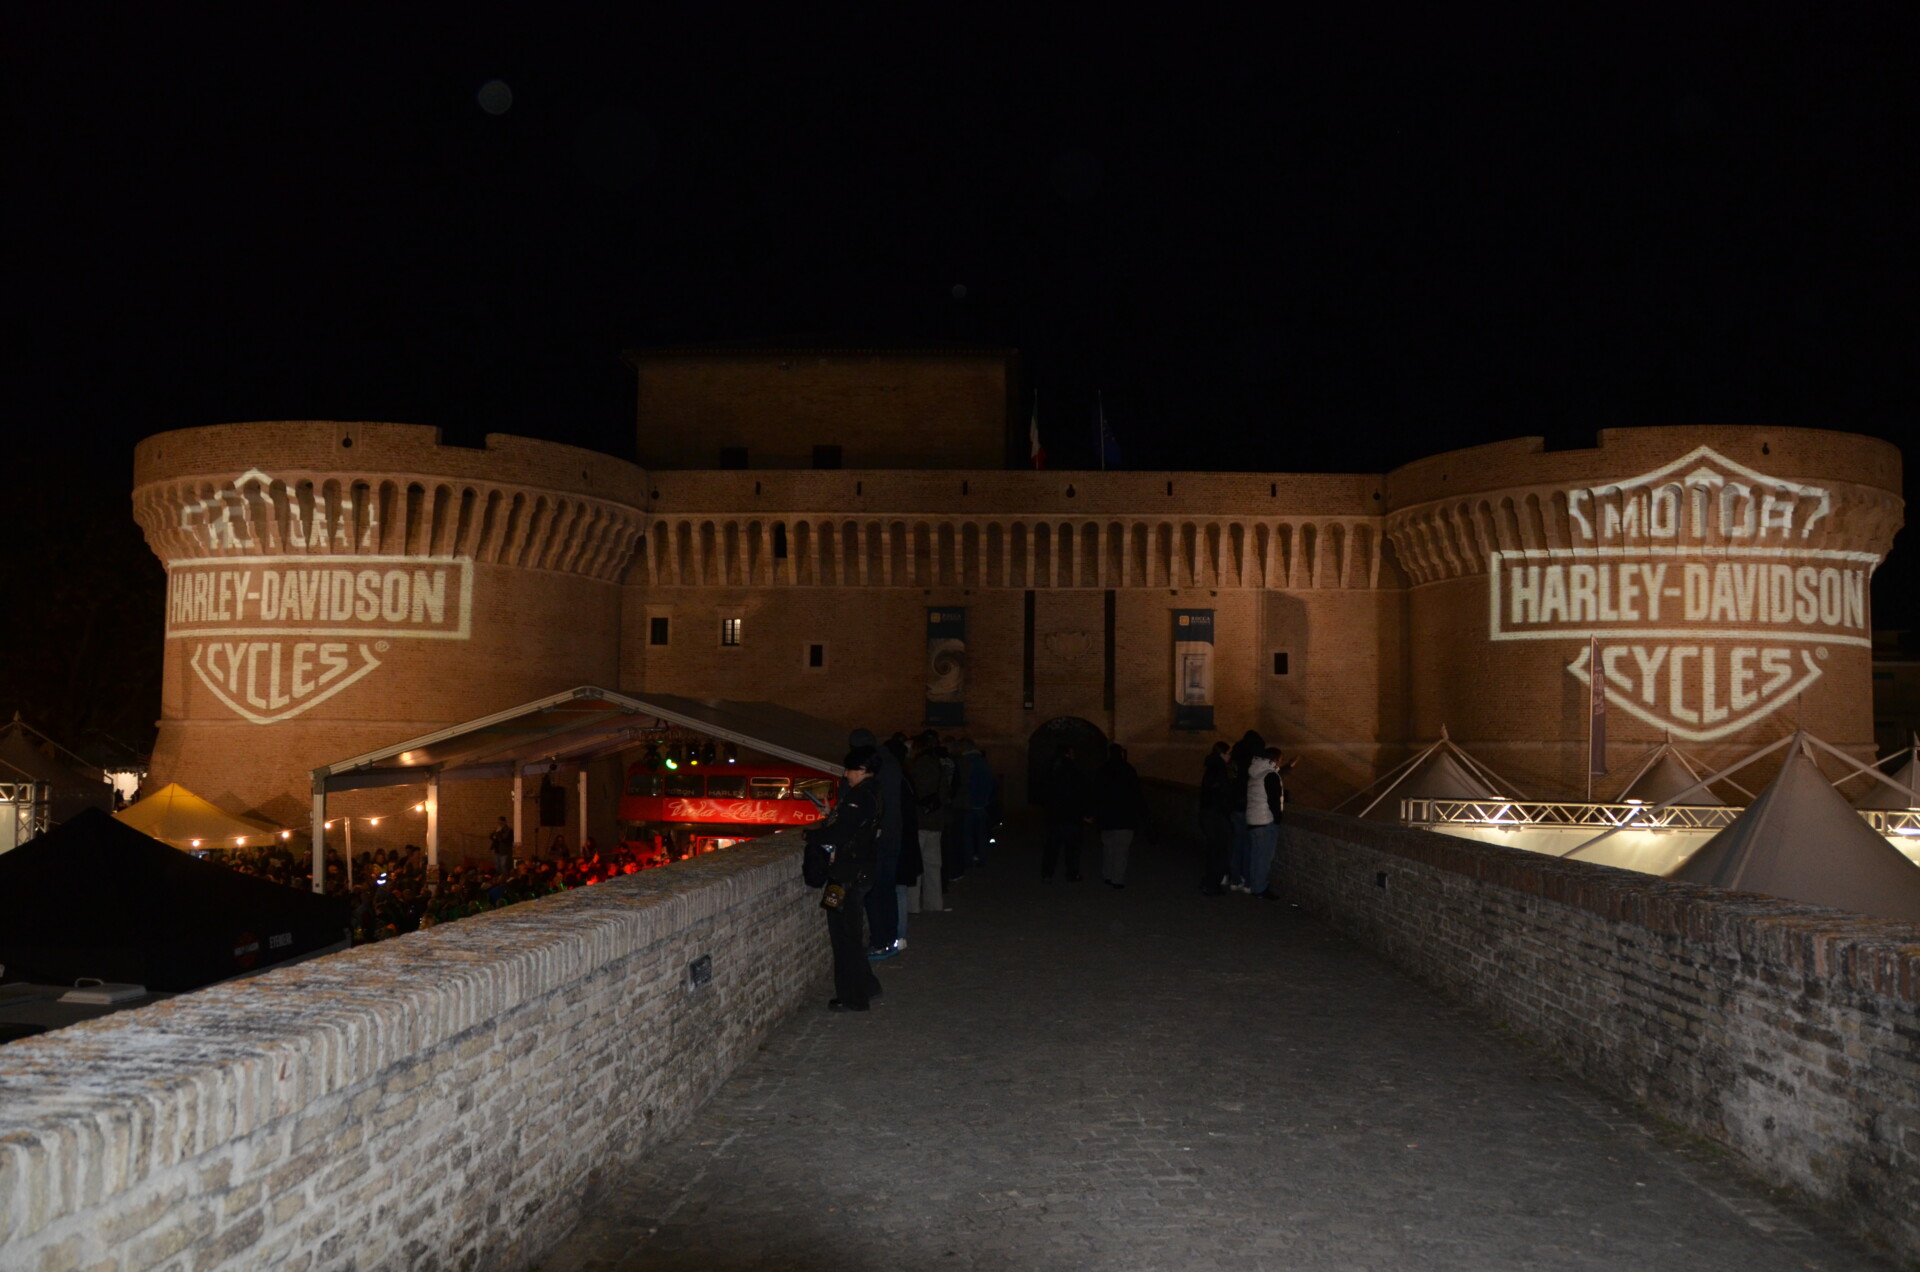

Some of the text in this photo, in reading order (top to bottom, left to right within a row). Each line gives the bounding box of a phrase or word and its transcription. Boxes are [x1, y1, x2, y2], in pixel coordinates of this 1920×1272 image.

[1604, 467, 1795, 539] MOTOR
[170, 568, 447, 624] HARLEY-DAVIDSON
[1511, 563, 1865, 629] HARLEY-DAVIDSON
[207, 642, 350, 710] CYCLES
[1602, 645, 1791, 724] CYCLES
